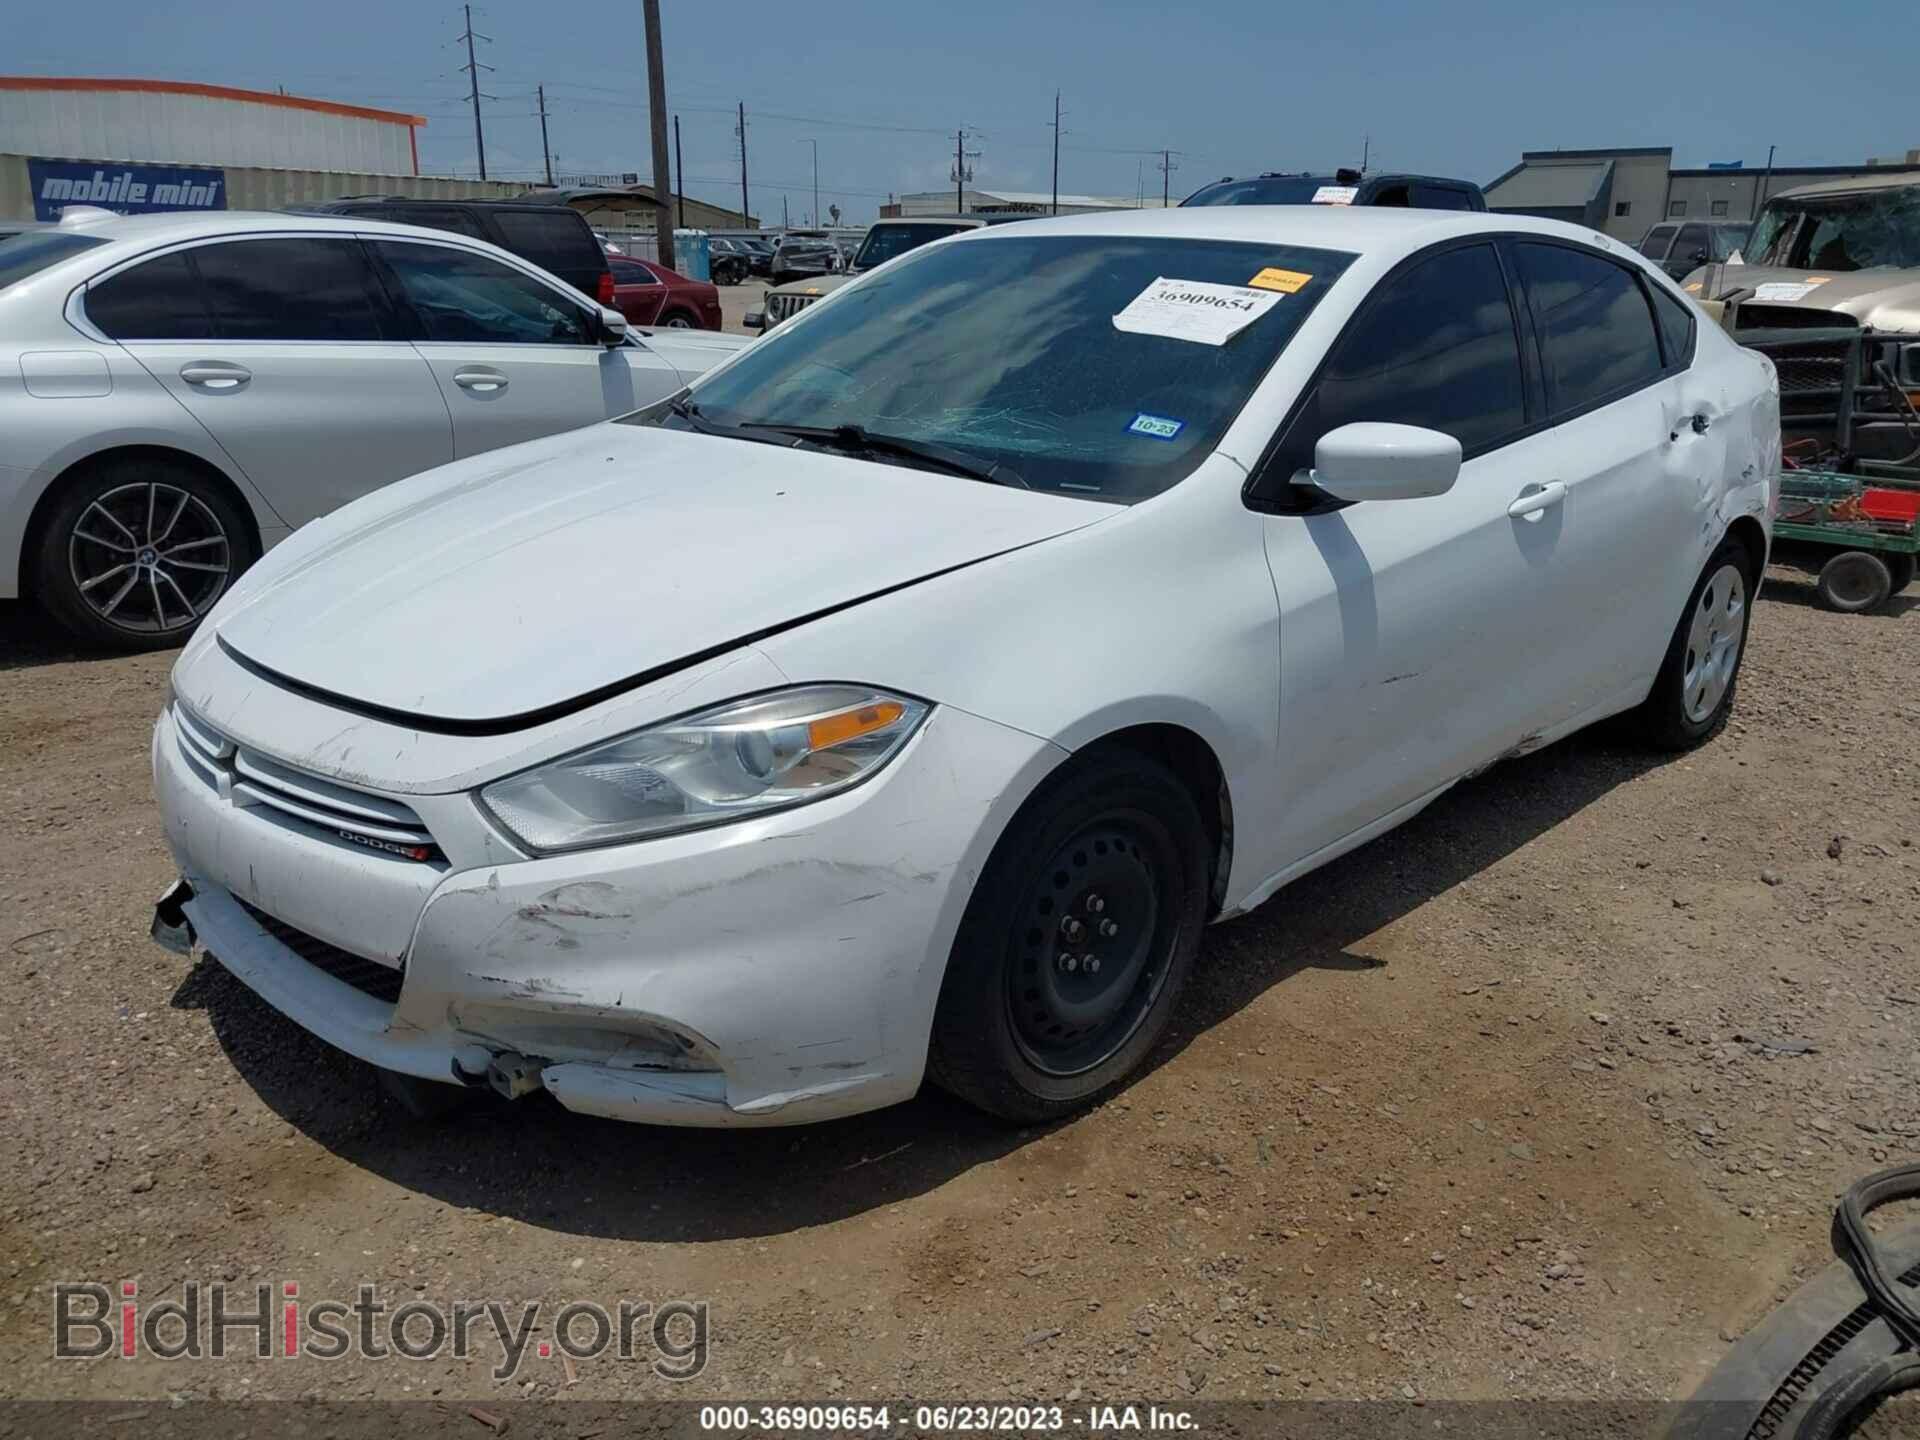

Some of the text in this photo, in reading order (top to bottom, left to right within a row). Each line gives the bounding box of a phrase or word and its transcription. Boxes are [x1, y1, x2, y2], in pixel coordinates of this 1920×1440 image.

[41, 171, 217, 206] mobile mini
[1151, 289, 1255, 312] 36909654
[340, 830, 416, 858] DODGE
